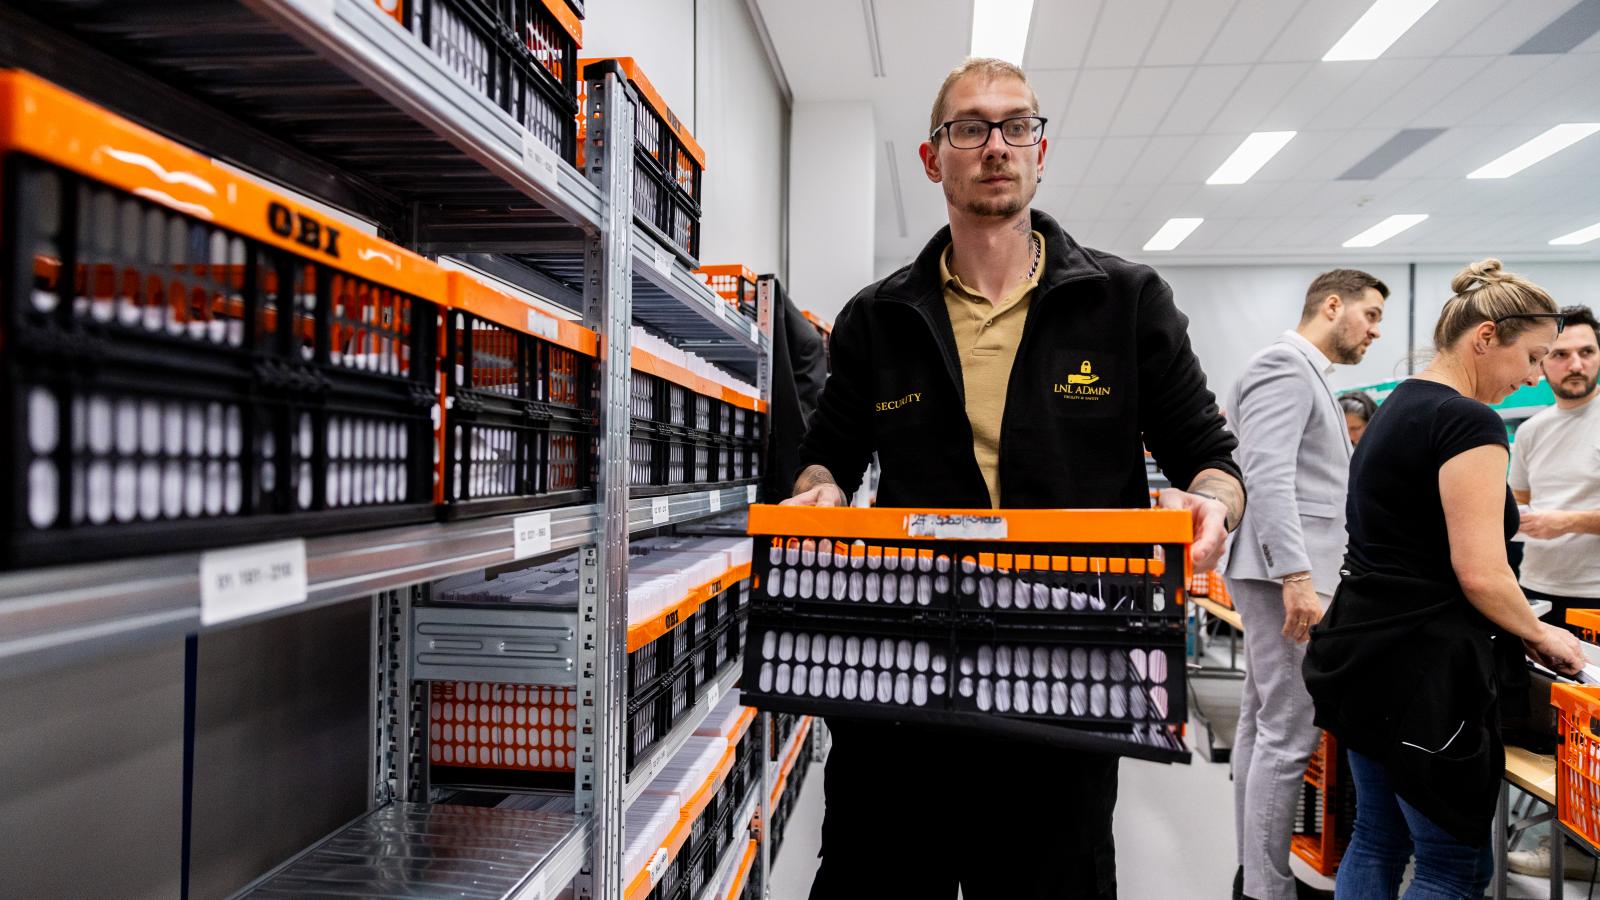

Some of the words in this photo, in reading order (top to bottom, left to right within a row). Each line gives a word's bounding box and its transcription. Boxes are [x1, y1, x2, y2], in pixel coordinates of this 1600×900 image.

[268, 201, 341, 259] OBI
[1054, 383, 1073, 394] LNL
[1075, 385, 1111, 396] ADMIN
[875, 393, 922, 411] SECURITY
[665, 609, 678, 628] OBI
